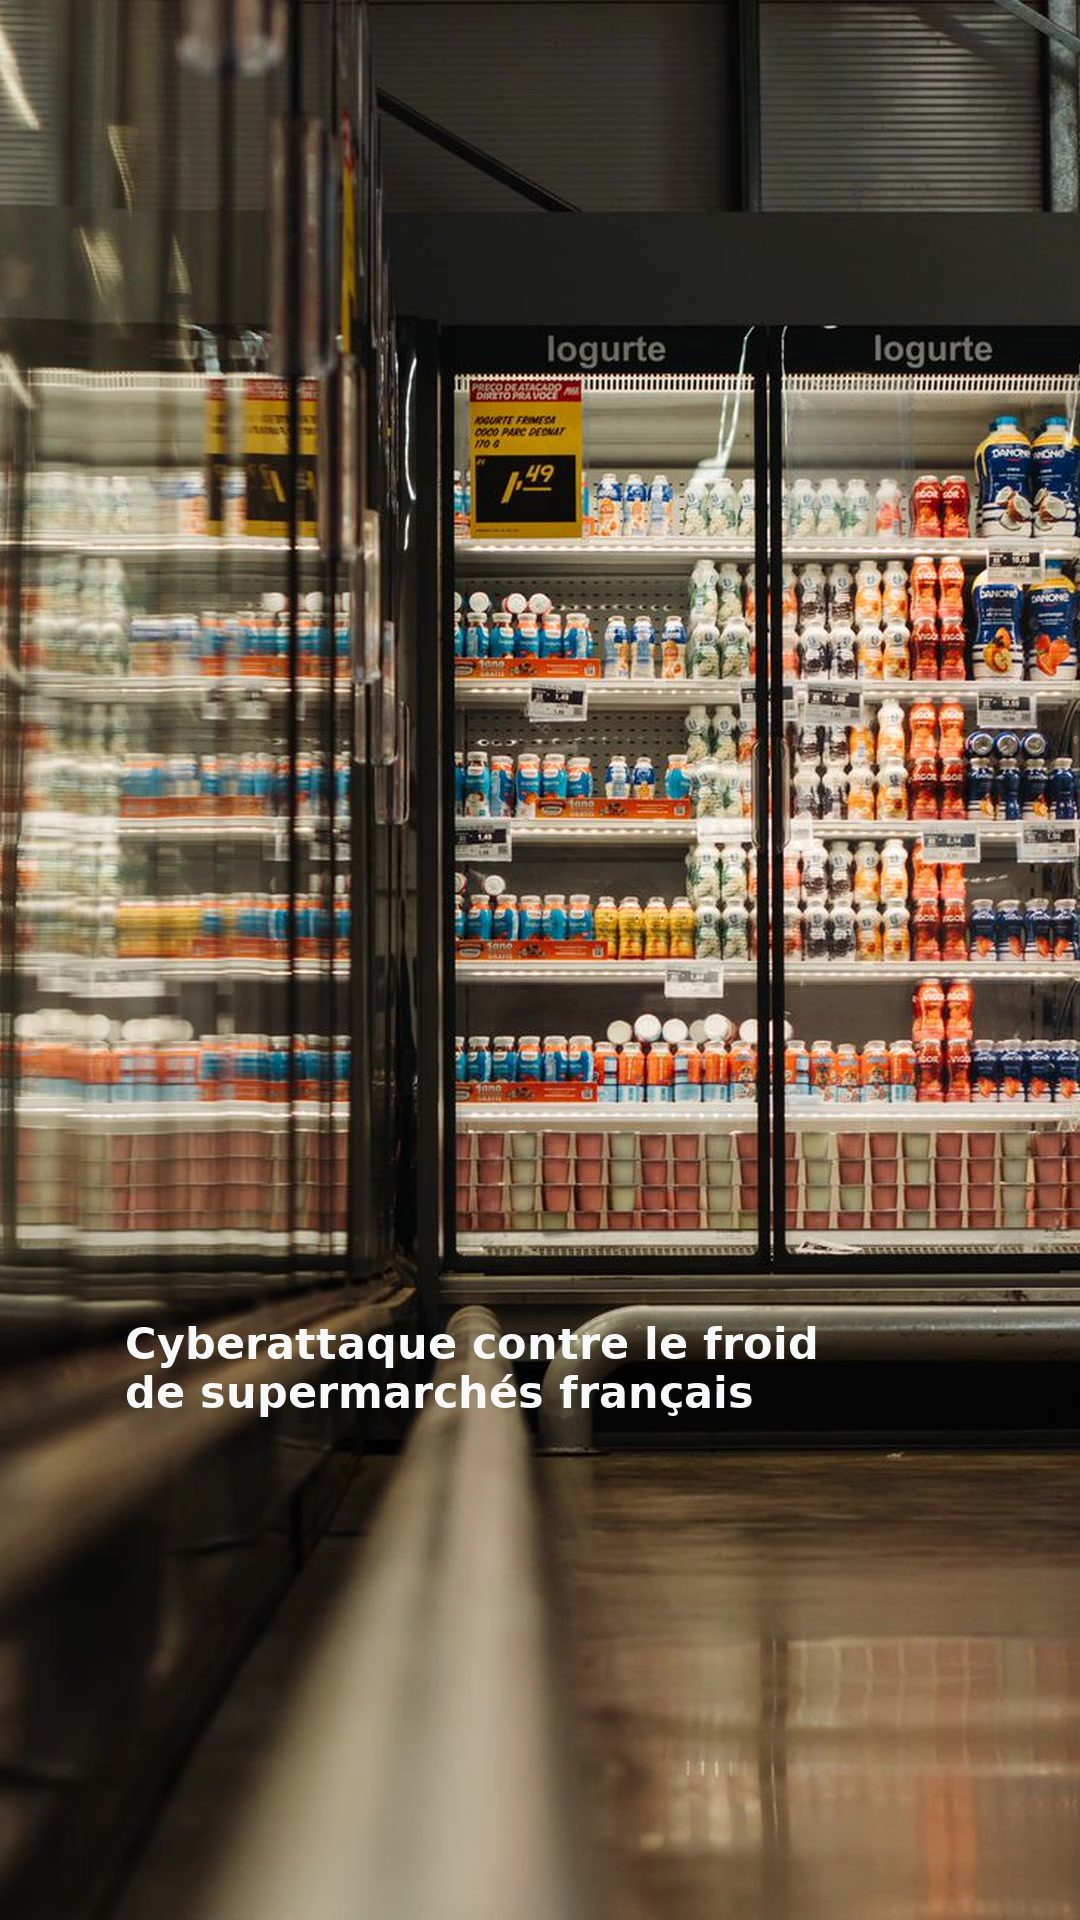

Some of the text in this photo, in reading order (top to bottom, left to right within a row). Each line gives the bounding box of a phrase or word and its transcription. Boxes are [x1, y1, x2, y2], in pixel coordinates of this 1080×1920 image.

[547, 335, 667, 368] Iogurte
[874, 334, 993, 368] Iogurte
[504, 383, 518, 392] DE
[518, 382, 562, 392] ATACADO
[476, 392, 510, 400] DIRETO
[511, 392, 532, 400] PRA
[474, 415, 556, 425] IOGURTE FRIMESA
[474, 427, 500, 437] COCO
[501, 427, 527, 437] PARC
